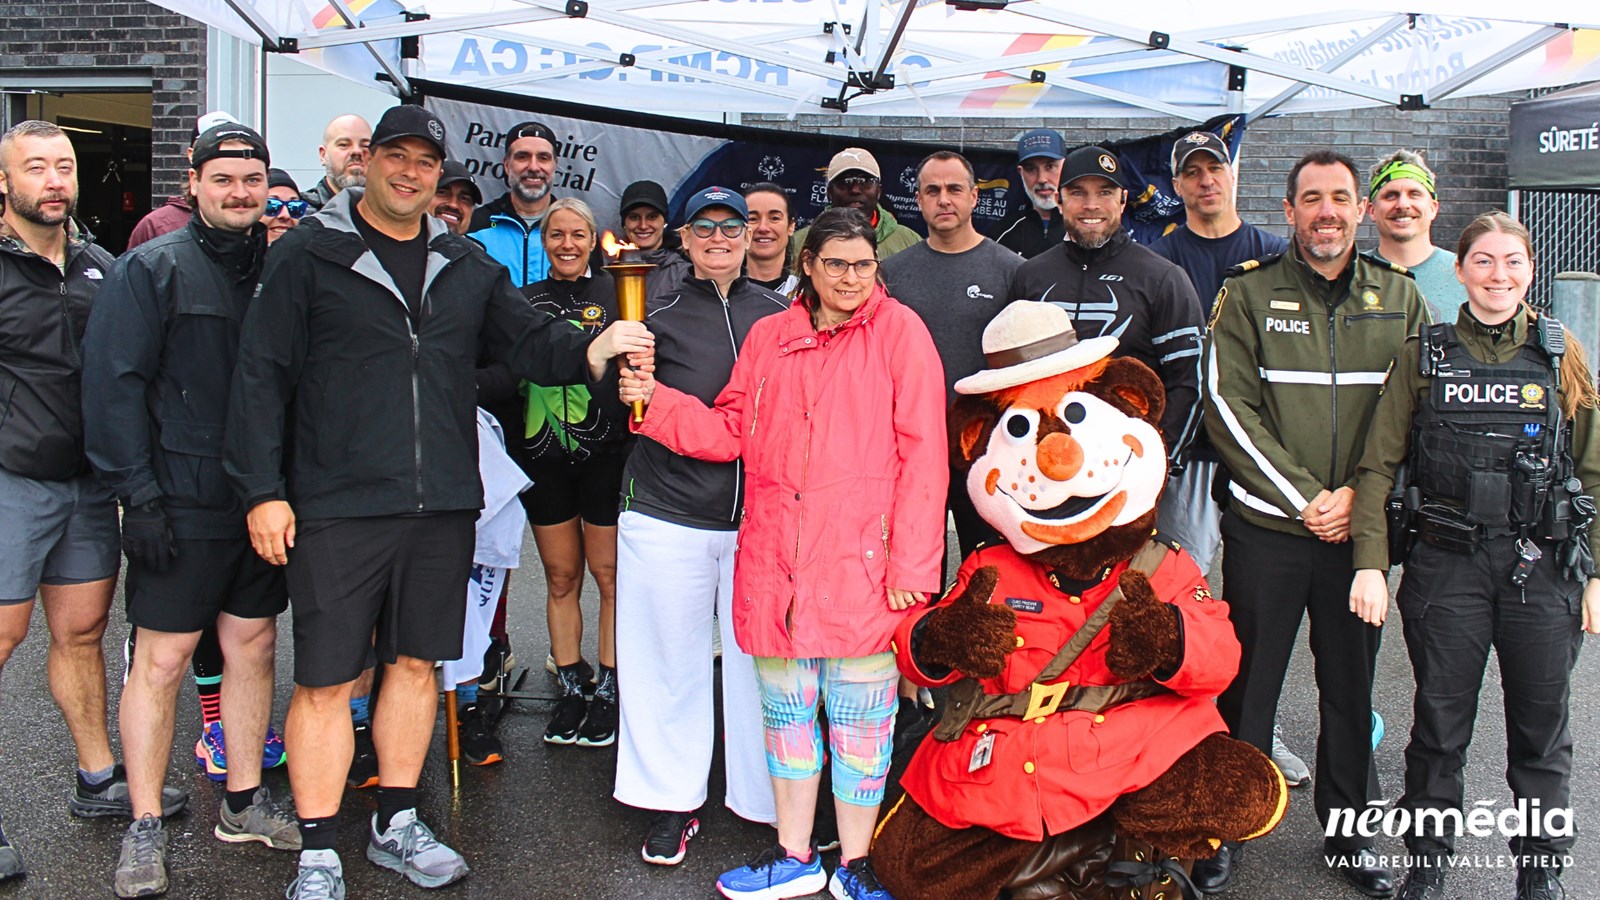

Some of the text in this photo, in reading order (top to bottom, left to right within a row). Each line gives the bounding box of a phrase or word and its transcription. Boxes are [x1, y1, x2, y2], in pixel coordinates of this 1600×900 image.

[464, 122, 598, 162] Paraire
[1539, 122, 1599, 153] SÛRETÉ
[464, 157, 597, 192] procial
[993, 199, 1007, 208] AU
[1266, 317, 1310, 335] POLICE
[1444, 383, 1519, 404] POLICE
